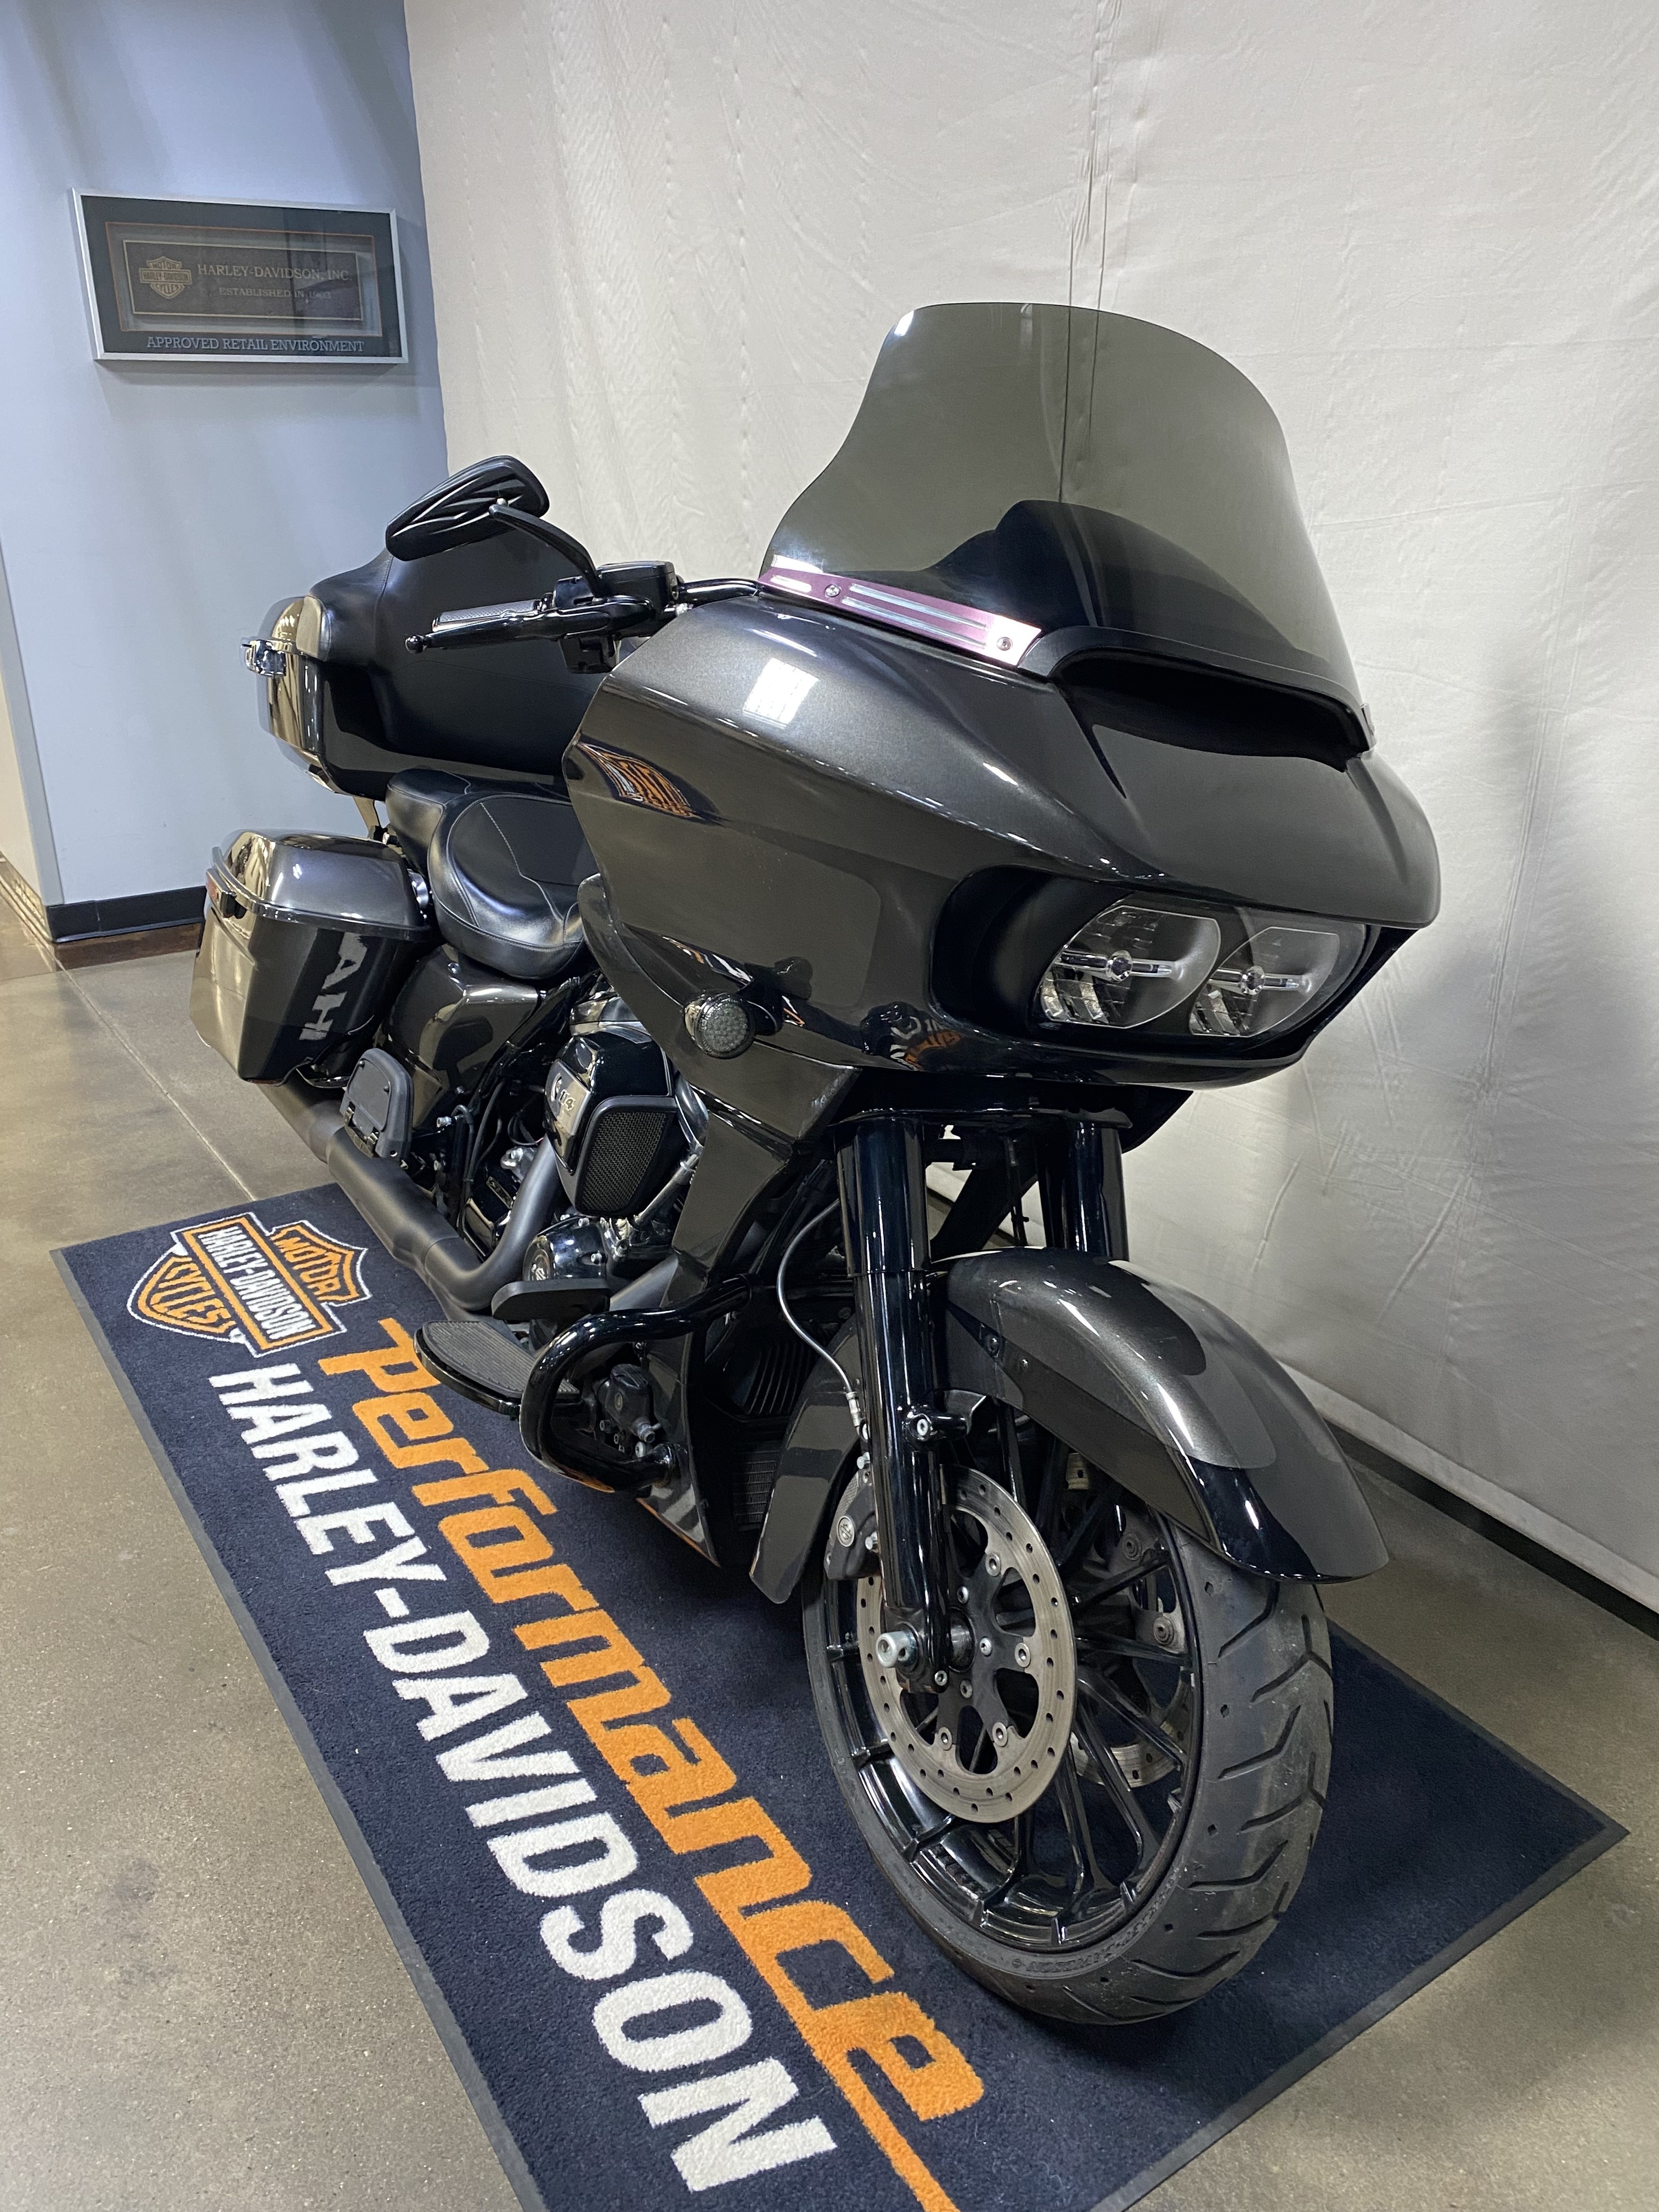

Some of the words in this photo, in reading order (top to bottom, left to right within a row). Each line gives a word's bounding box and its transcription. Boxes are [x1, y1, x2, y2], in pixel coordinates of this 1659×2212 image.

[219, 287, 291, 298] ESTABLISHED
[294, 290, 304, 298] IN
[146, 336, 219, 349] APPROVED
[222, 338, 268, 351] RETAIL
[270, 339, 364, 353] ENVIRONMENT
[558, 1088, 577, 1111] 114
[150, 1263, 232, 1325] CYCLES
[198, 1226, 318, 1340] HARLEY-DAVIDSON
[275, 1236, 342, 1296] MOTOR
[318, 1317, 985, 2121] Performance
[208, 1363, 837, 2192] HARLEY-DAVIDSON
